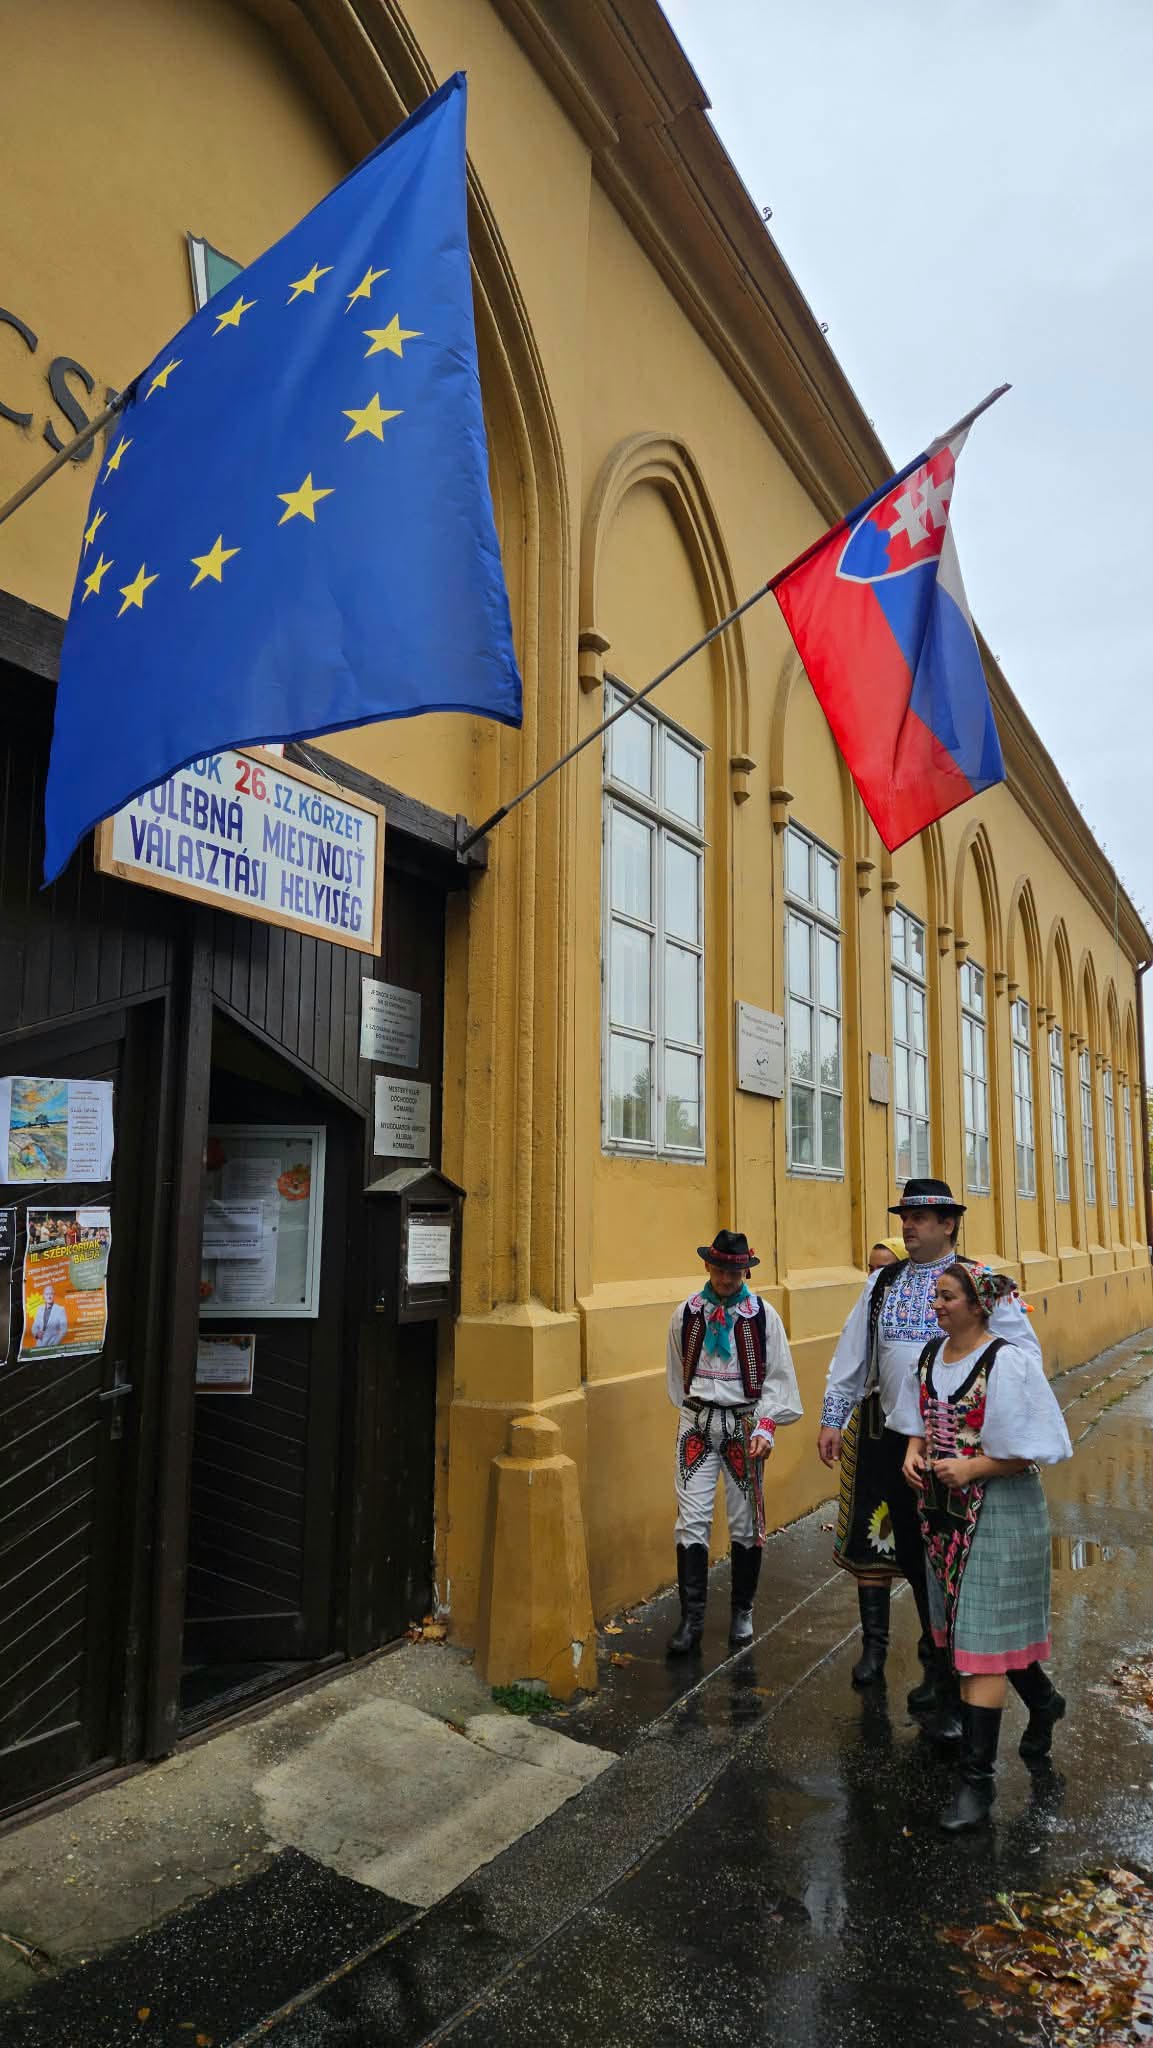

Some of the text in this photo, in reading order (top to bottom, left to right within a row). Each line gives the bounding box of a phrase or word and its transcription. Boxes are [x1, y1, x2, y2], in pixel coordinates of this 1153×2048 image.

[183, 756, 223, 785] OK
[234, 759, 271, 805] 26.
[299, 794, 363, 843] KÖRZET
[129, 814, 363, 932] VÁLASZTÁSI HELYISÉG
[263, 814, 366, 889] MIESTNOSŤ
